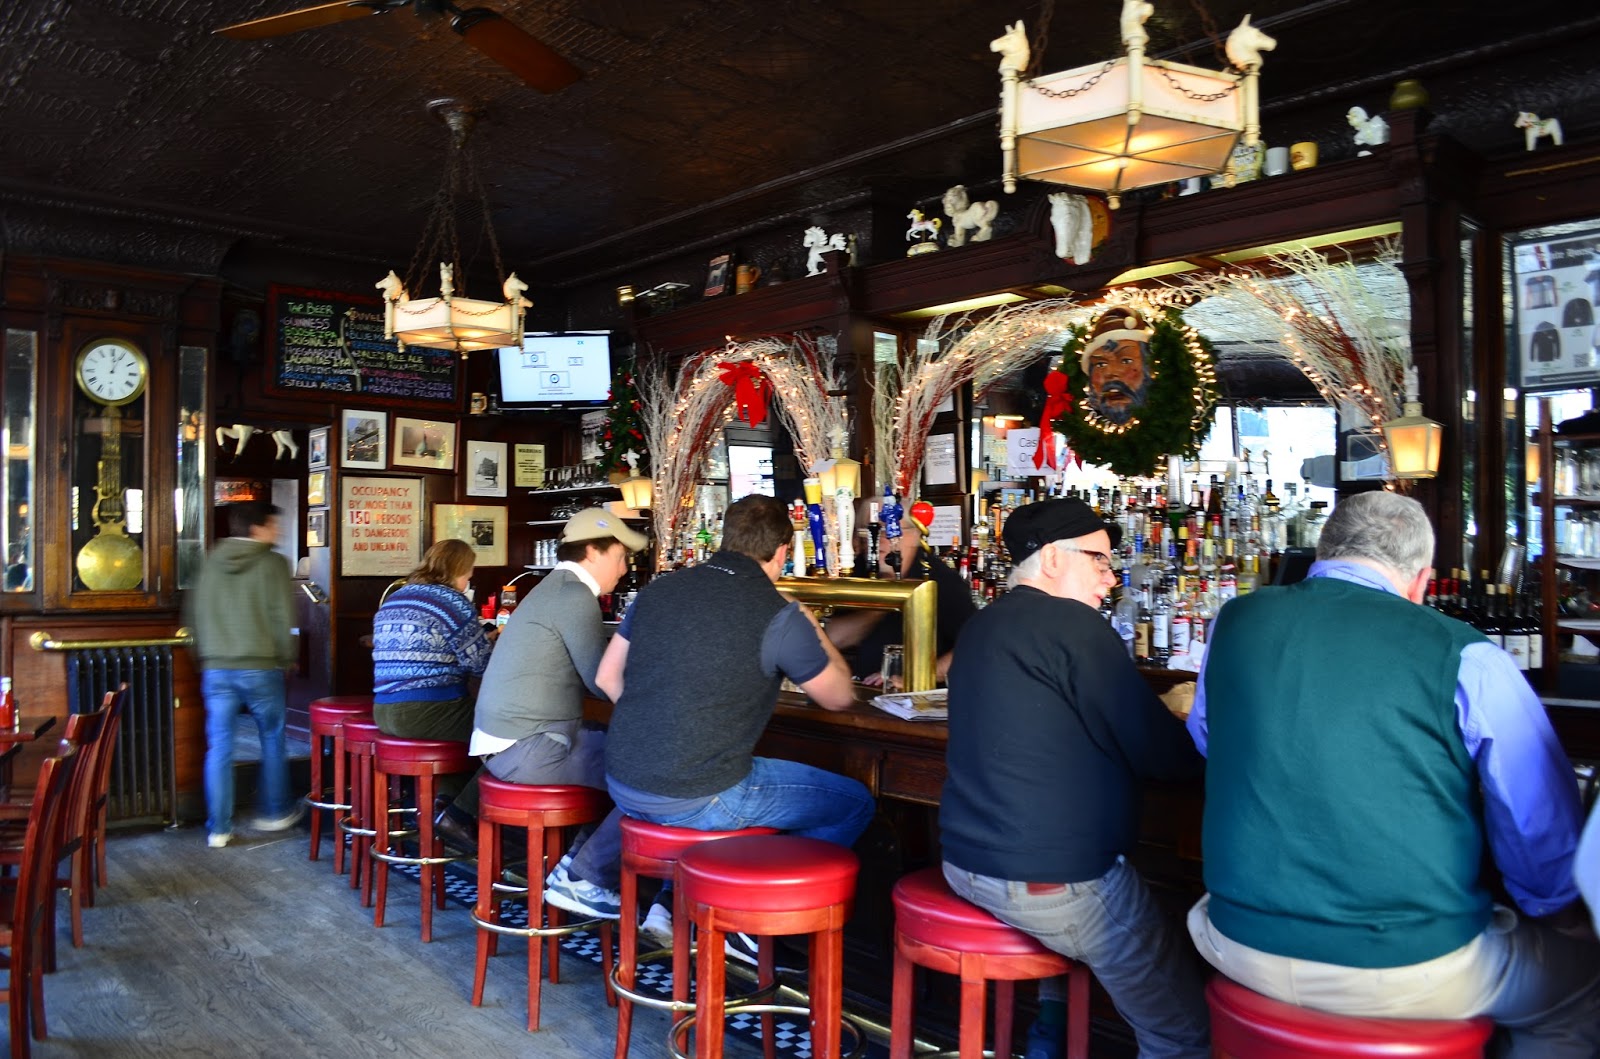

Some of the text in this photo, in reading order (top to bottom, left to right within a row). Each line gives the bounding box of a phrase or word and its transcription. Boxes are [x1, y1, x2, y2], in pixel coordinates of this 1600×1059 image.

[307, 302, 334, 314] BEER
[284, 379, 318, 388] STELLA
[351, 486, 410, 497] OCCUPANCY
[349, 500, 413, 510] BY MORE THAN
[349, 510, 412, 525] 150 PERSONS
[351, 528, 410, 538] IS DANGEROUS
[353, 542, 409, 552] AND UNLAWFUL
